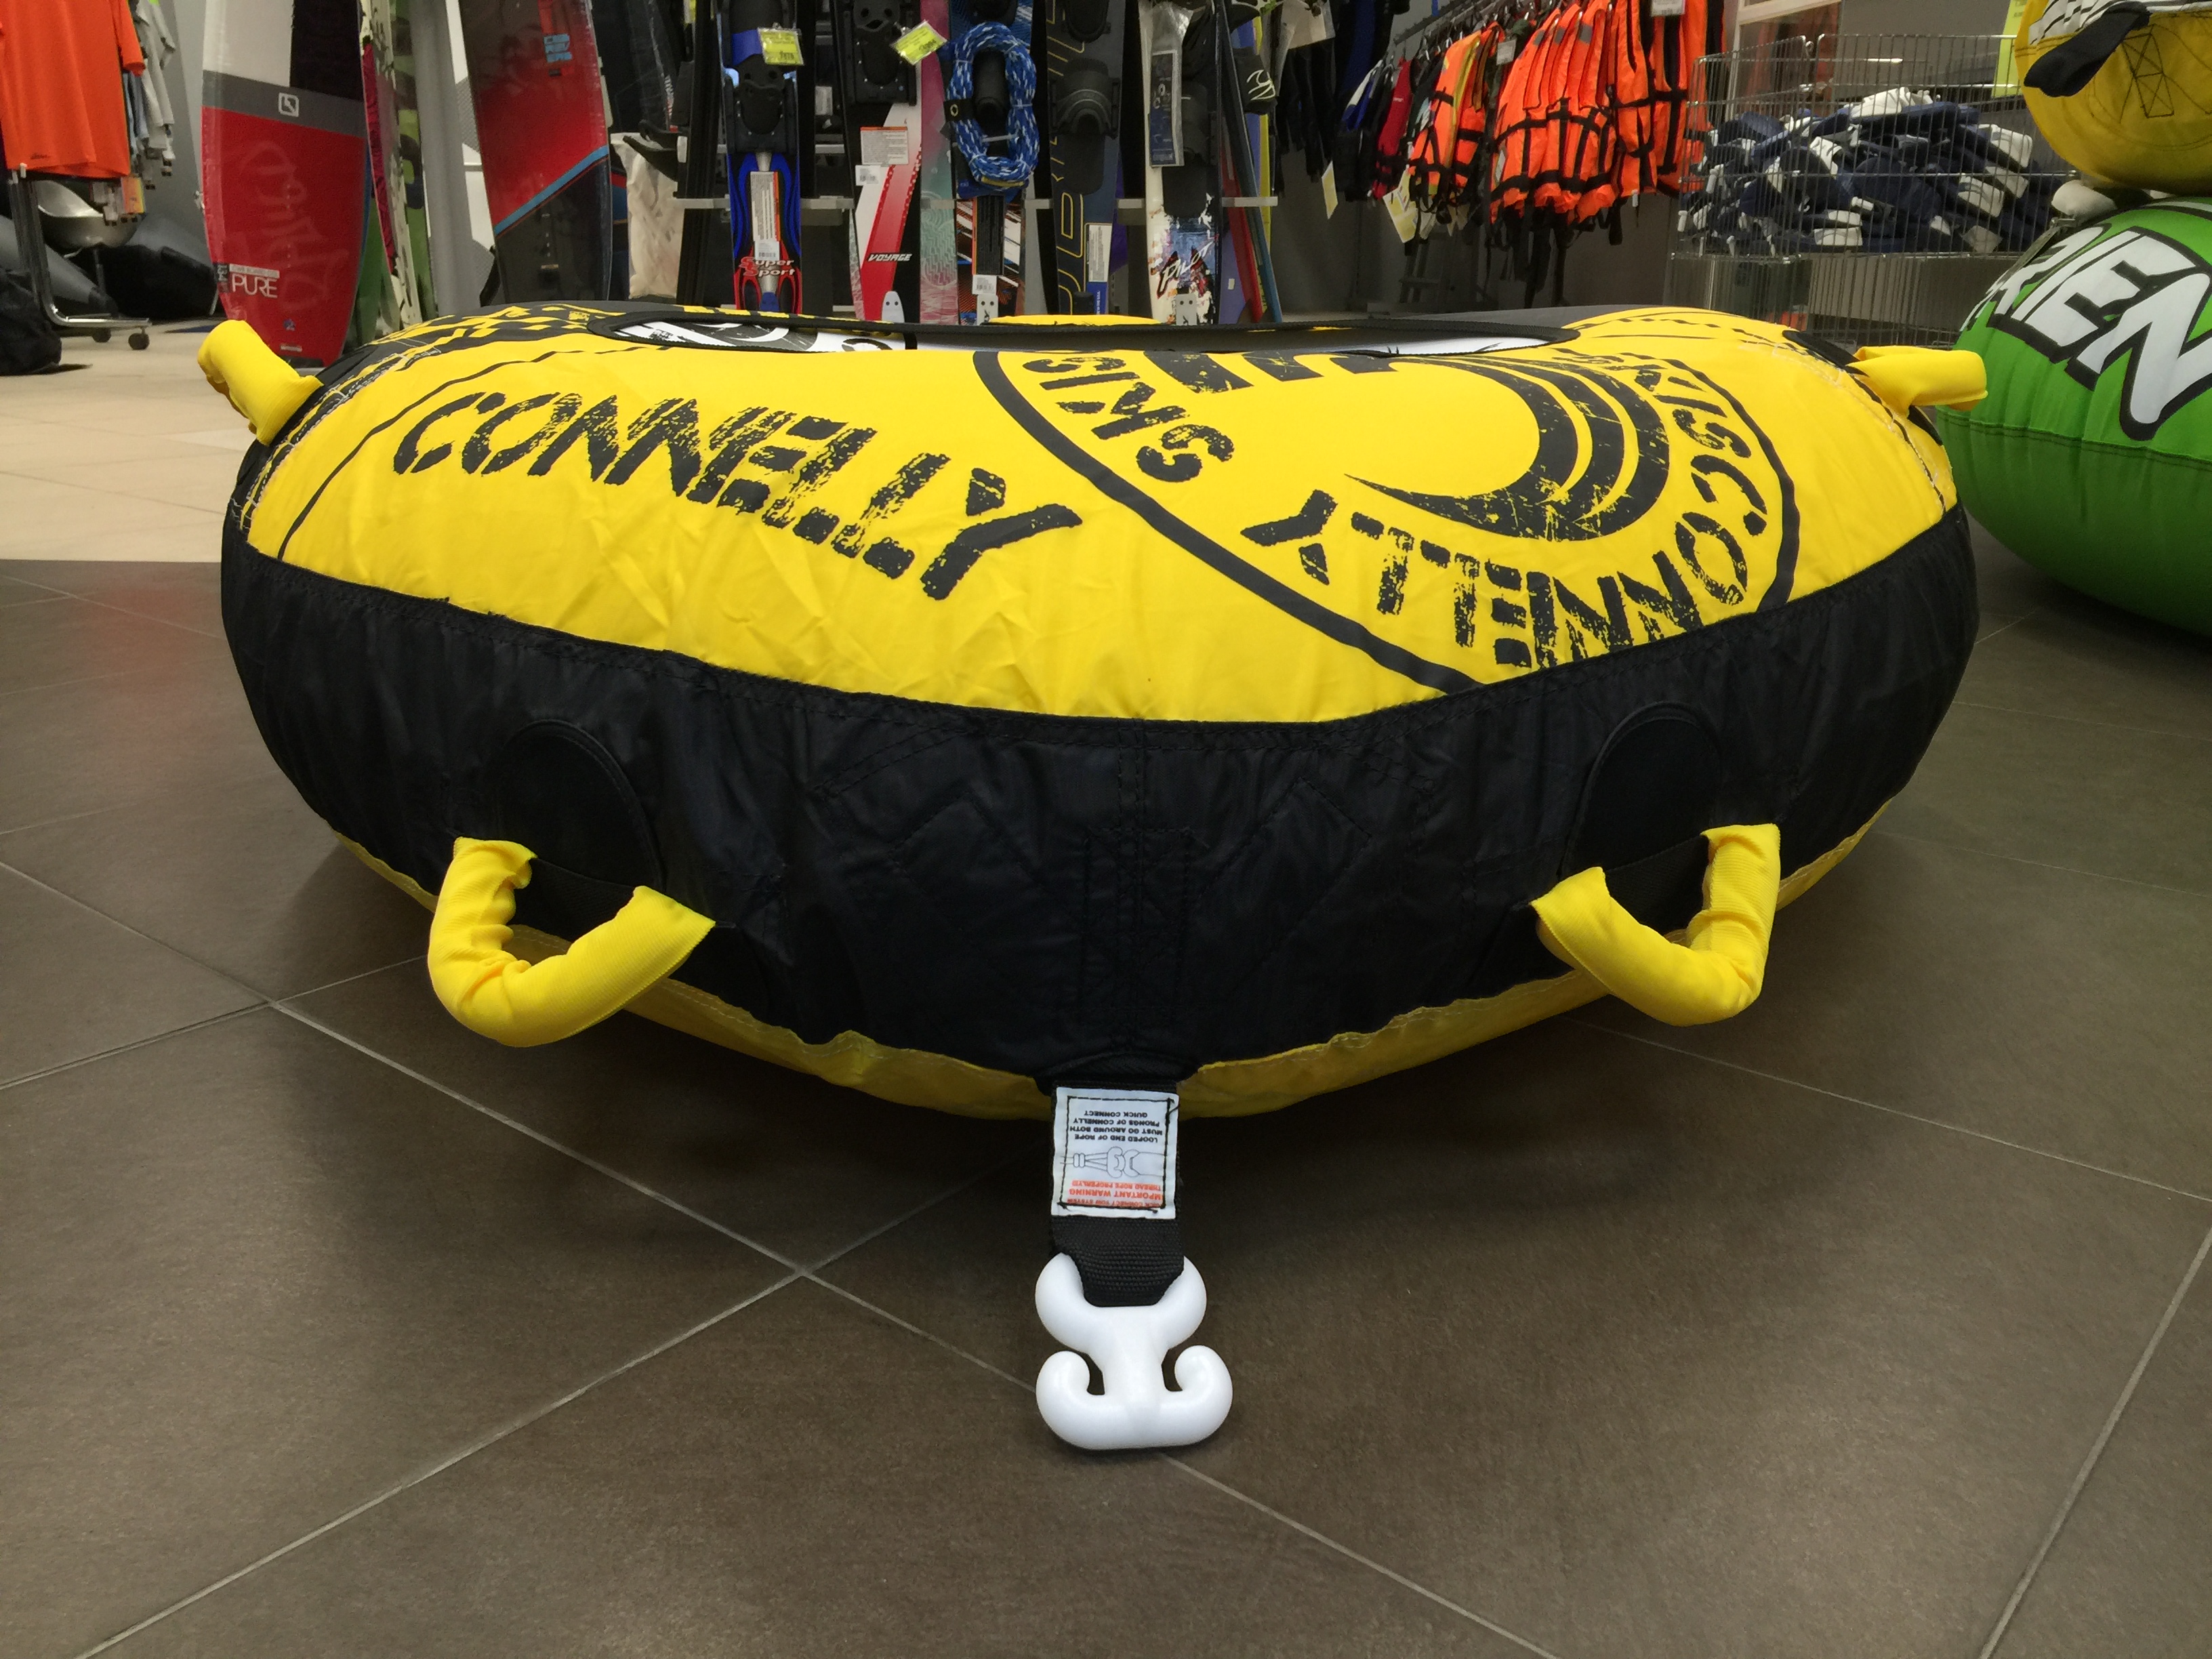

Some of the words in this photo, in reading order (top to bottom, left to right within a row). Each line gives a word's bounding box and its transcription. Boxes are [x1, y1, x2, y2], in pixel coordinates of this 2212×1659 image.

[739, 256, 794, 268] Super
[867, 253, 913, 262] VOYAGE
[743, 263, 796, 277] Sport
[232, 273, 278, 298] PURE
[1022, 356, 1235, 483] SKIS
[392, 391, 1083, 600] CONNELLY
[1240, 453, 1768, 669] CONNELLY
[1069, 1188, 1111, 1197] WARNING
[1113, 1190, 1162, 1200] MPORTANT
